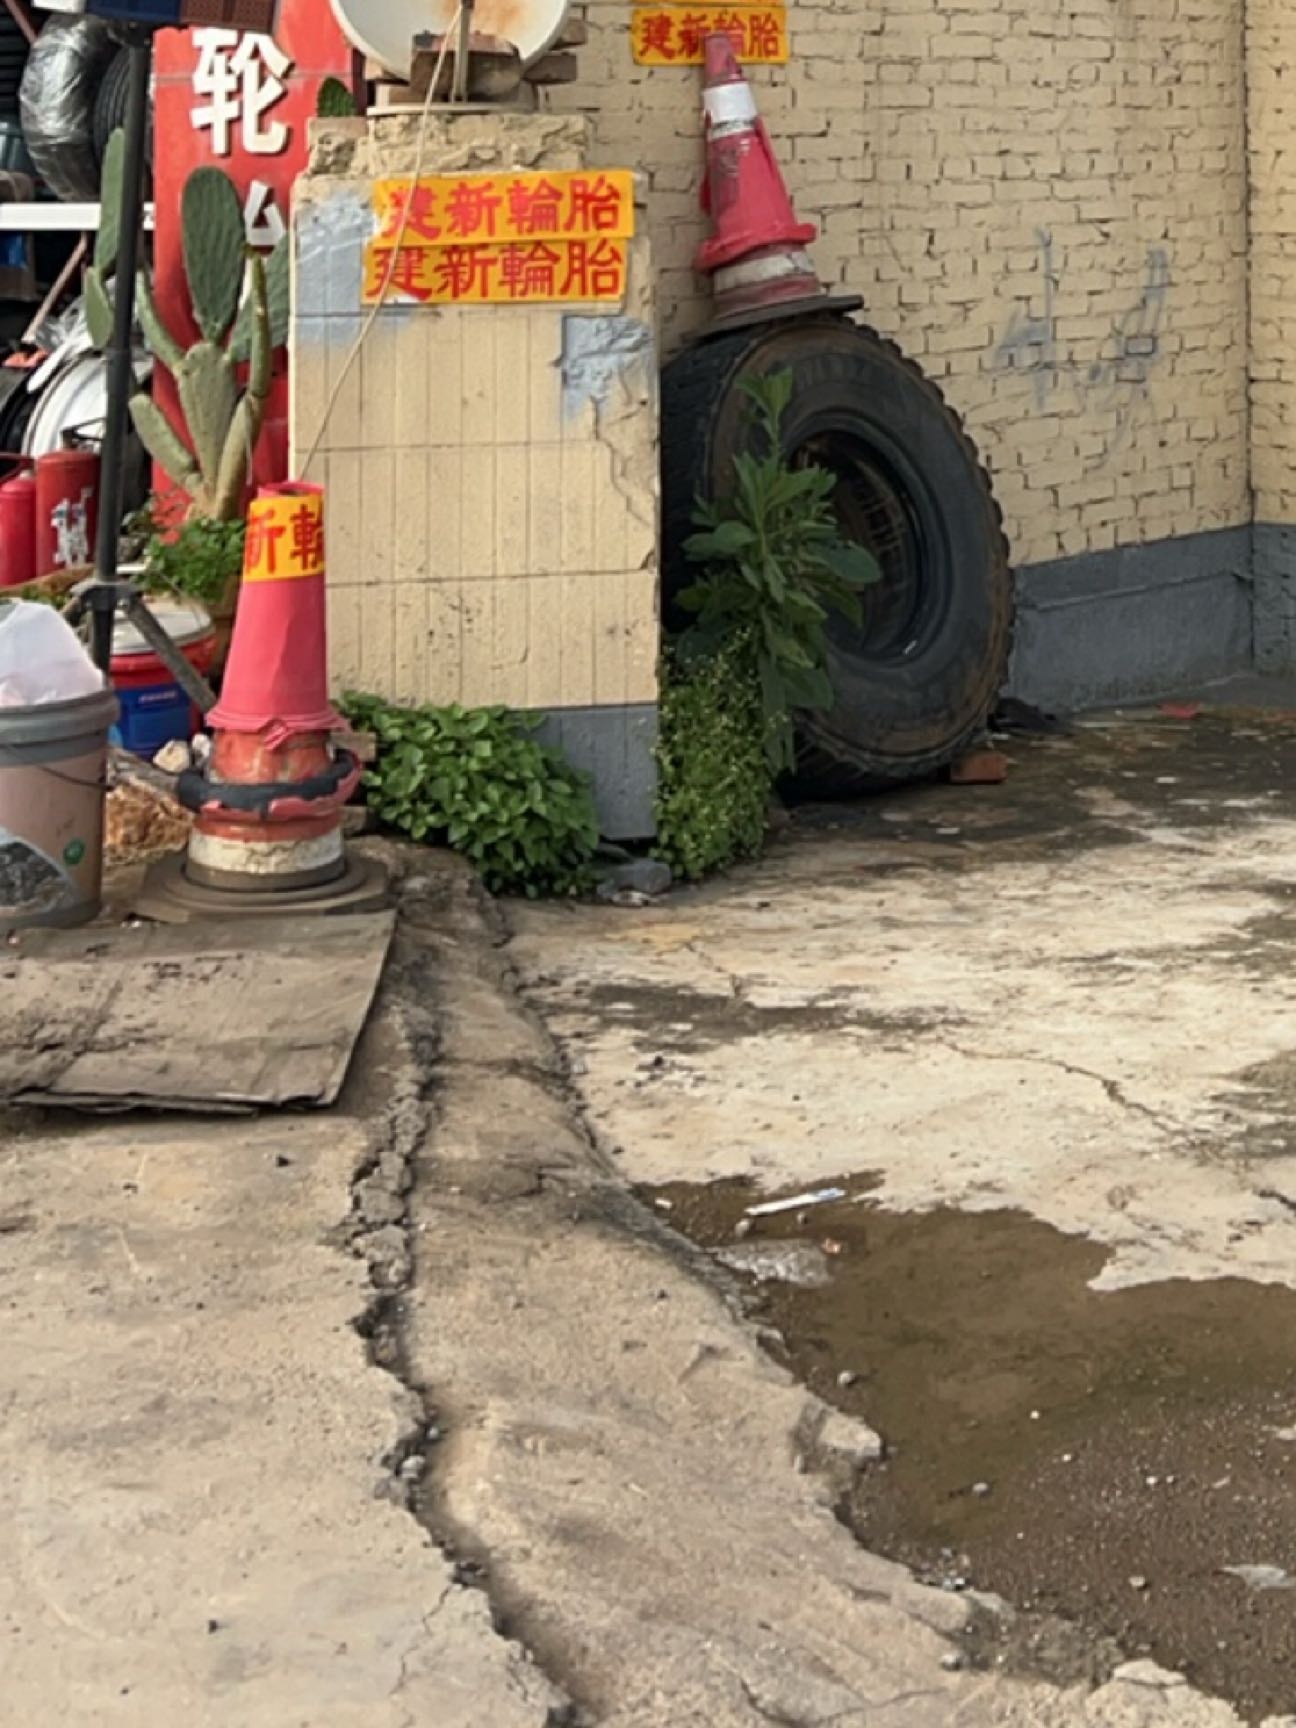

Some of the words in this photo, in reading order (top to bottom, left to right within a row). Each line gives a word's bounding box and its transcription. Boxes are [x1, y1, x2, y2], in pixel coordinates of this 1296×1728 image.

[381, 175, 621, 239] 建新輪胎
[366, 238, 622, 300] 建新輪胎
